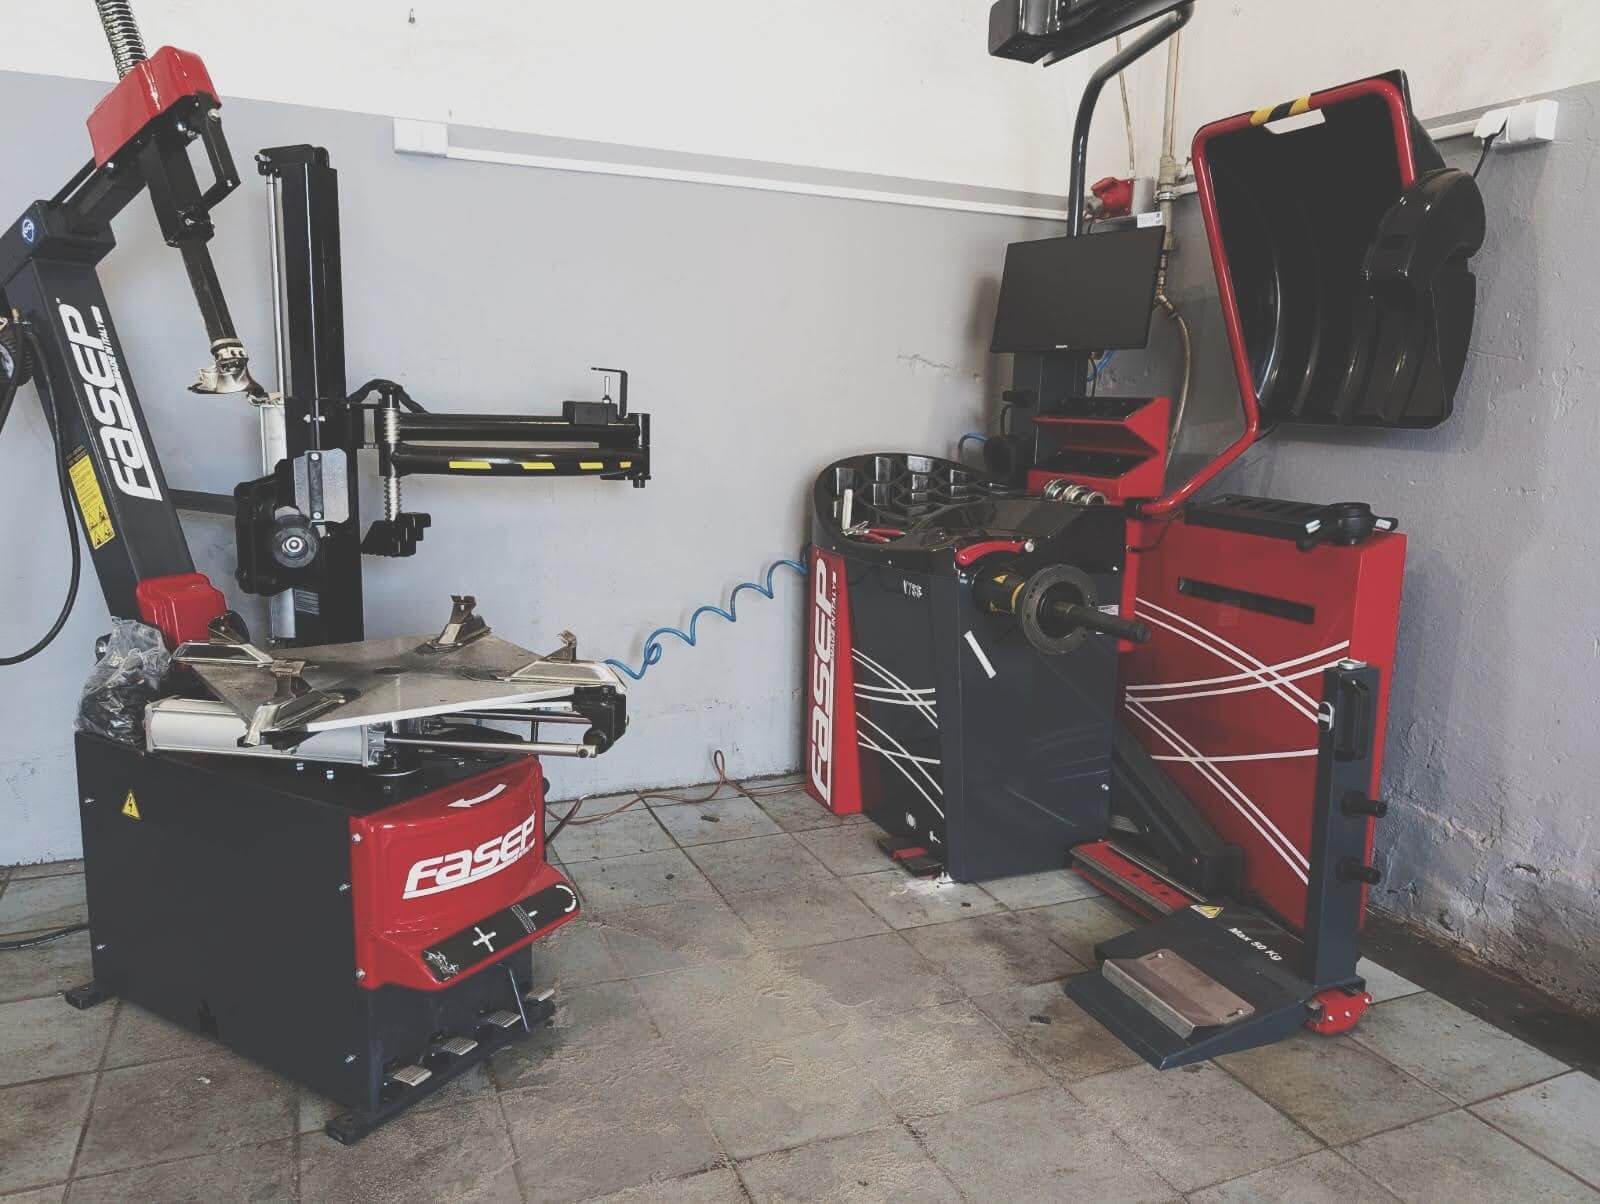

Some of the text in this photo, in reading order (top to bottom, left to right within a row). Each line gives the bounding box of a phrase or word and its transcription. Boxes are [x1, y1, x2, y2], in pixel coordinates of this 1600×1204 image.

[97, 322, 110, 346] ITALY
[1227, 928, 1252, 941] Max
[1250, 941, 1267, 950] 50
